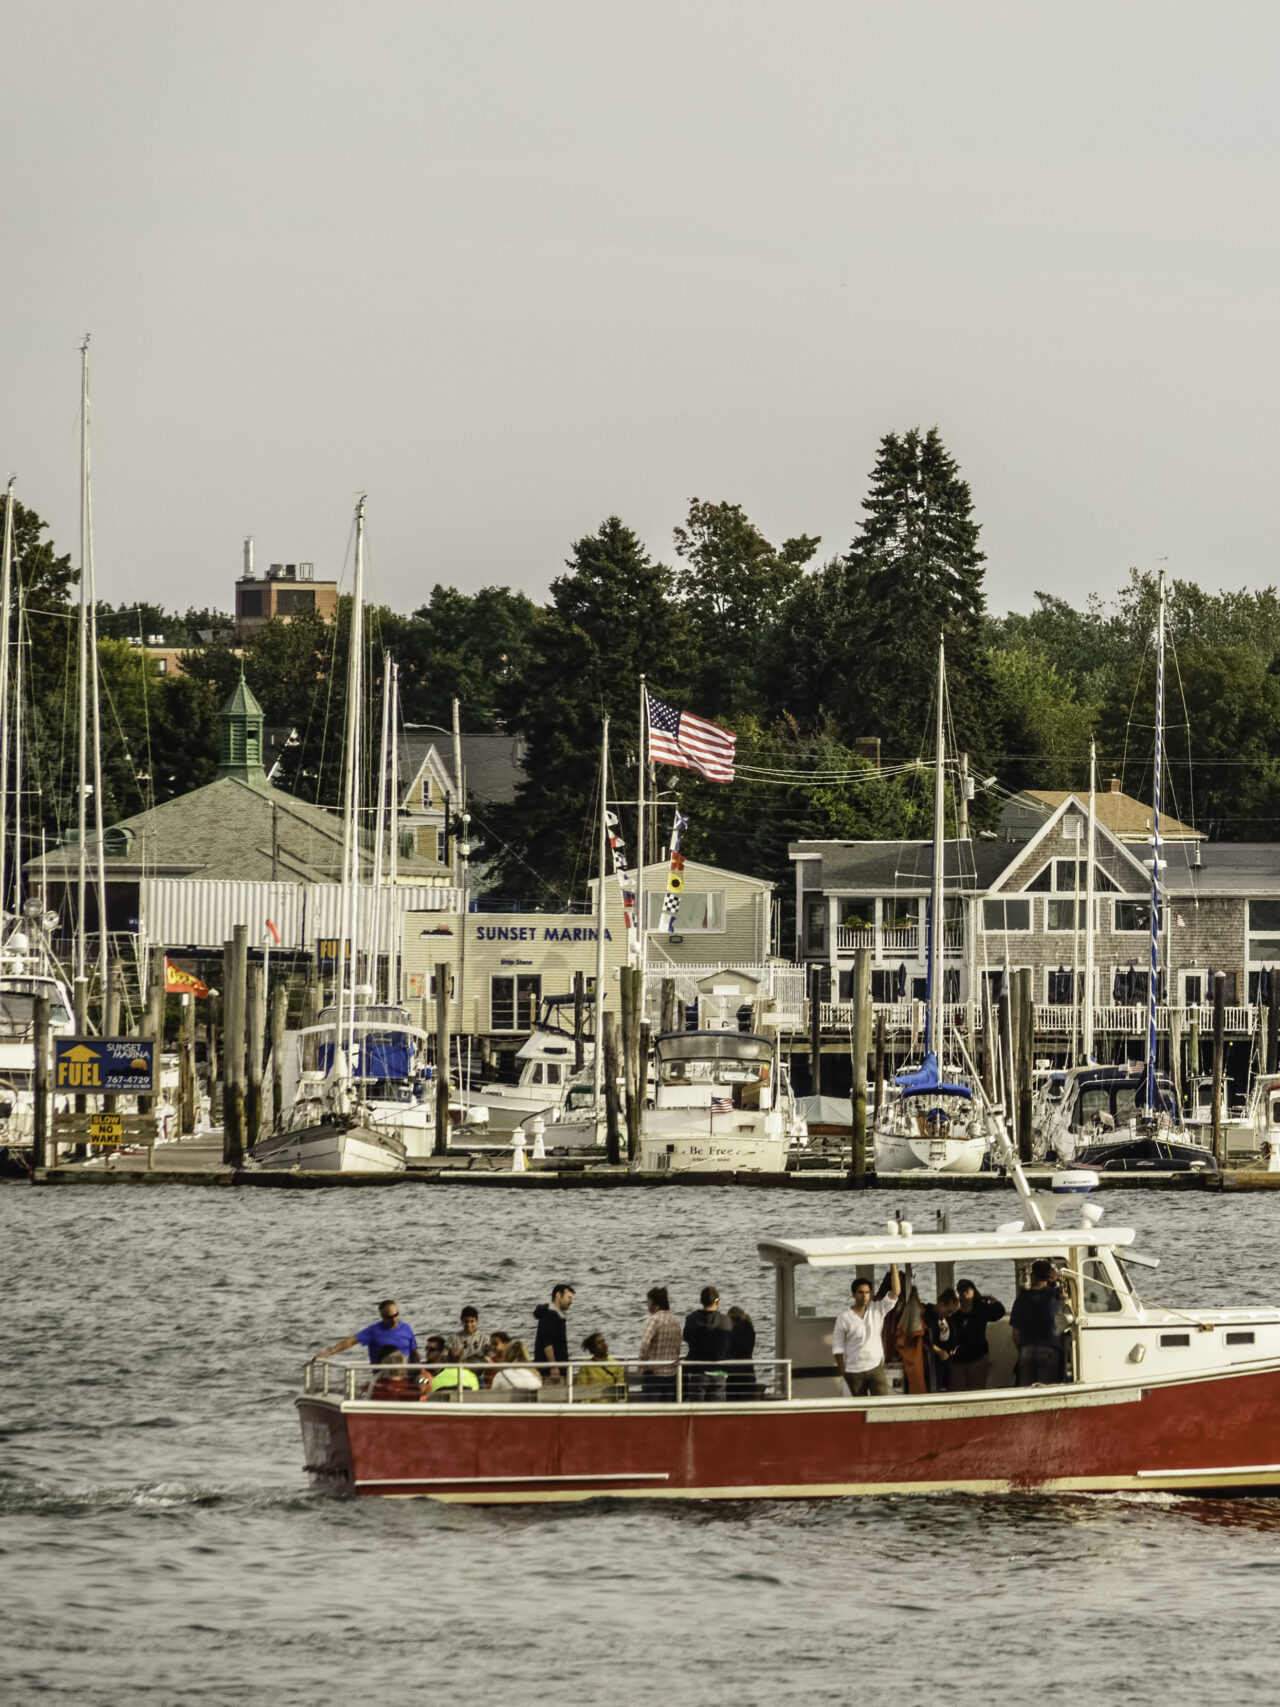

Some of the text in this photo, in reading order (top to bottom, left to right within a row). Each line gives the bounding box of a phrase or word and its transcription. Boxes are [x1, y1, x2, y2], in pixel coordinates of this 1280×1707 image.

[476, 926, 613, 942] SUNSET MARINA
[318, 940, 350, 959] FUL
[106, 1043, 142, 1052] SUNSET
[112, 1051, 150, 1059] MARINA
[58, 1062, 102, 1086] FUEL
[107, 1076, 150, 1084] 767-4729
[92, 1115, 120, 1124] SLOW
[98, 1125, 113, 1134] NO
[91, 1134, 121, 1143] WAKE
